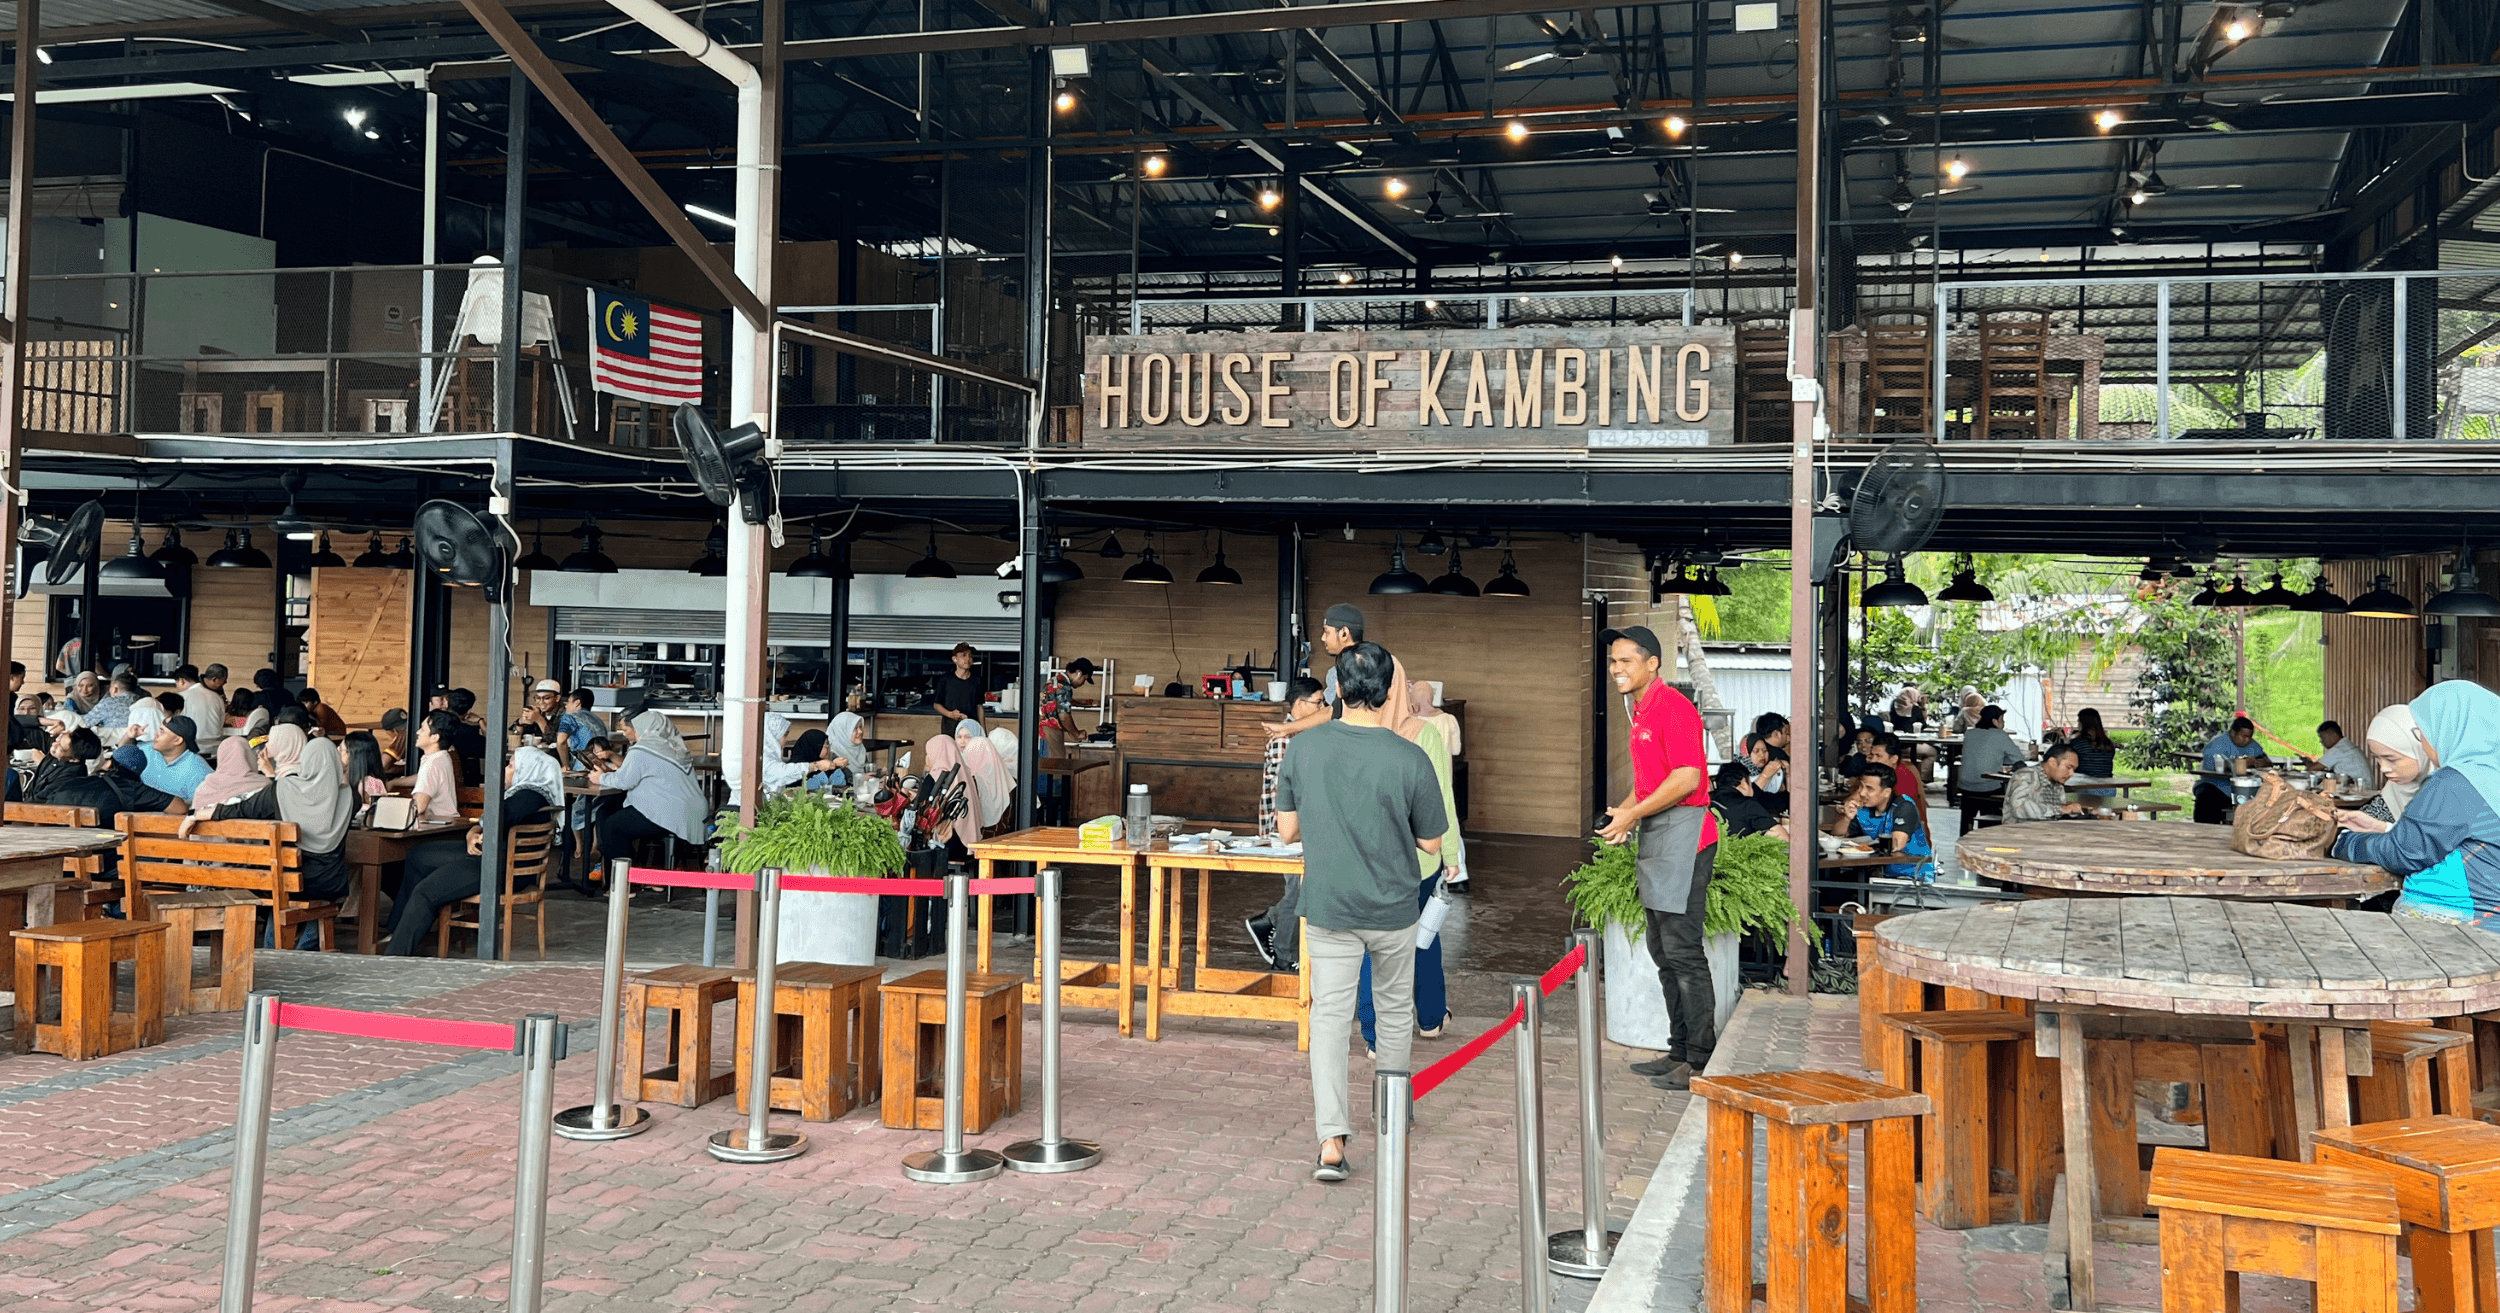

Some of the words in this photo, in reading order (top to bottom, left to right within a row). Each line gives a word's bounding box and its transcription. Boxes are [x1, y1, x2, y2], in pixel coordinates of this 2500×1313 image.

[1100, 352, 1292, 428] HOUSE
[1329, 351, 1397, 428] OF
[1419, 343, 1711, 428] KAMBING
